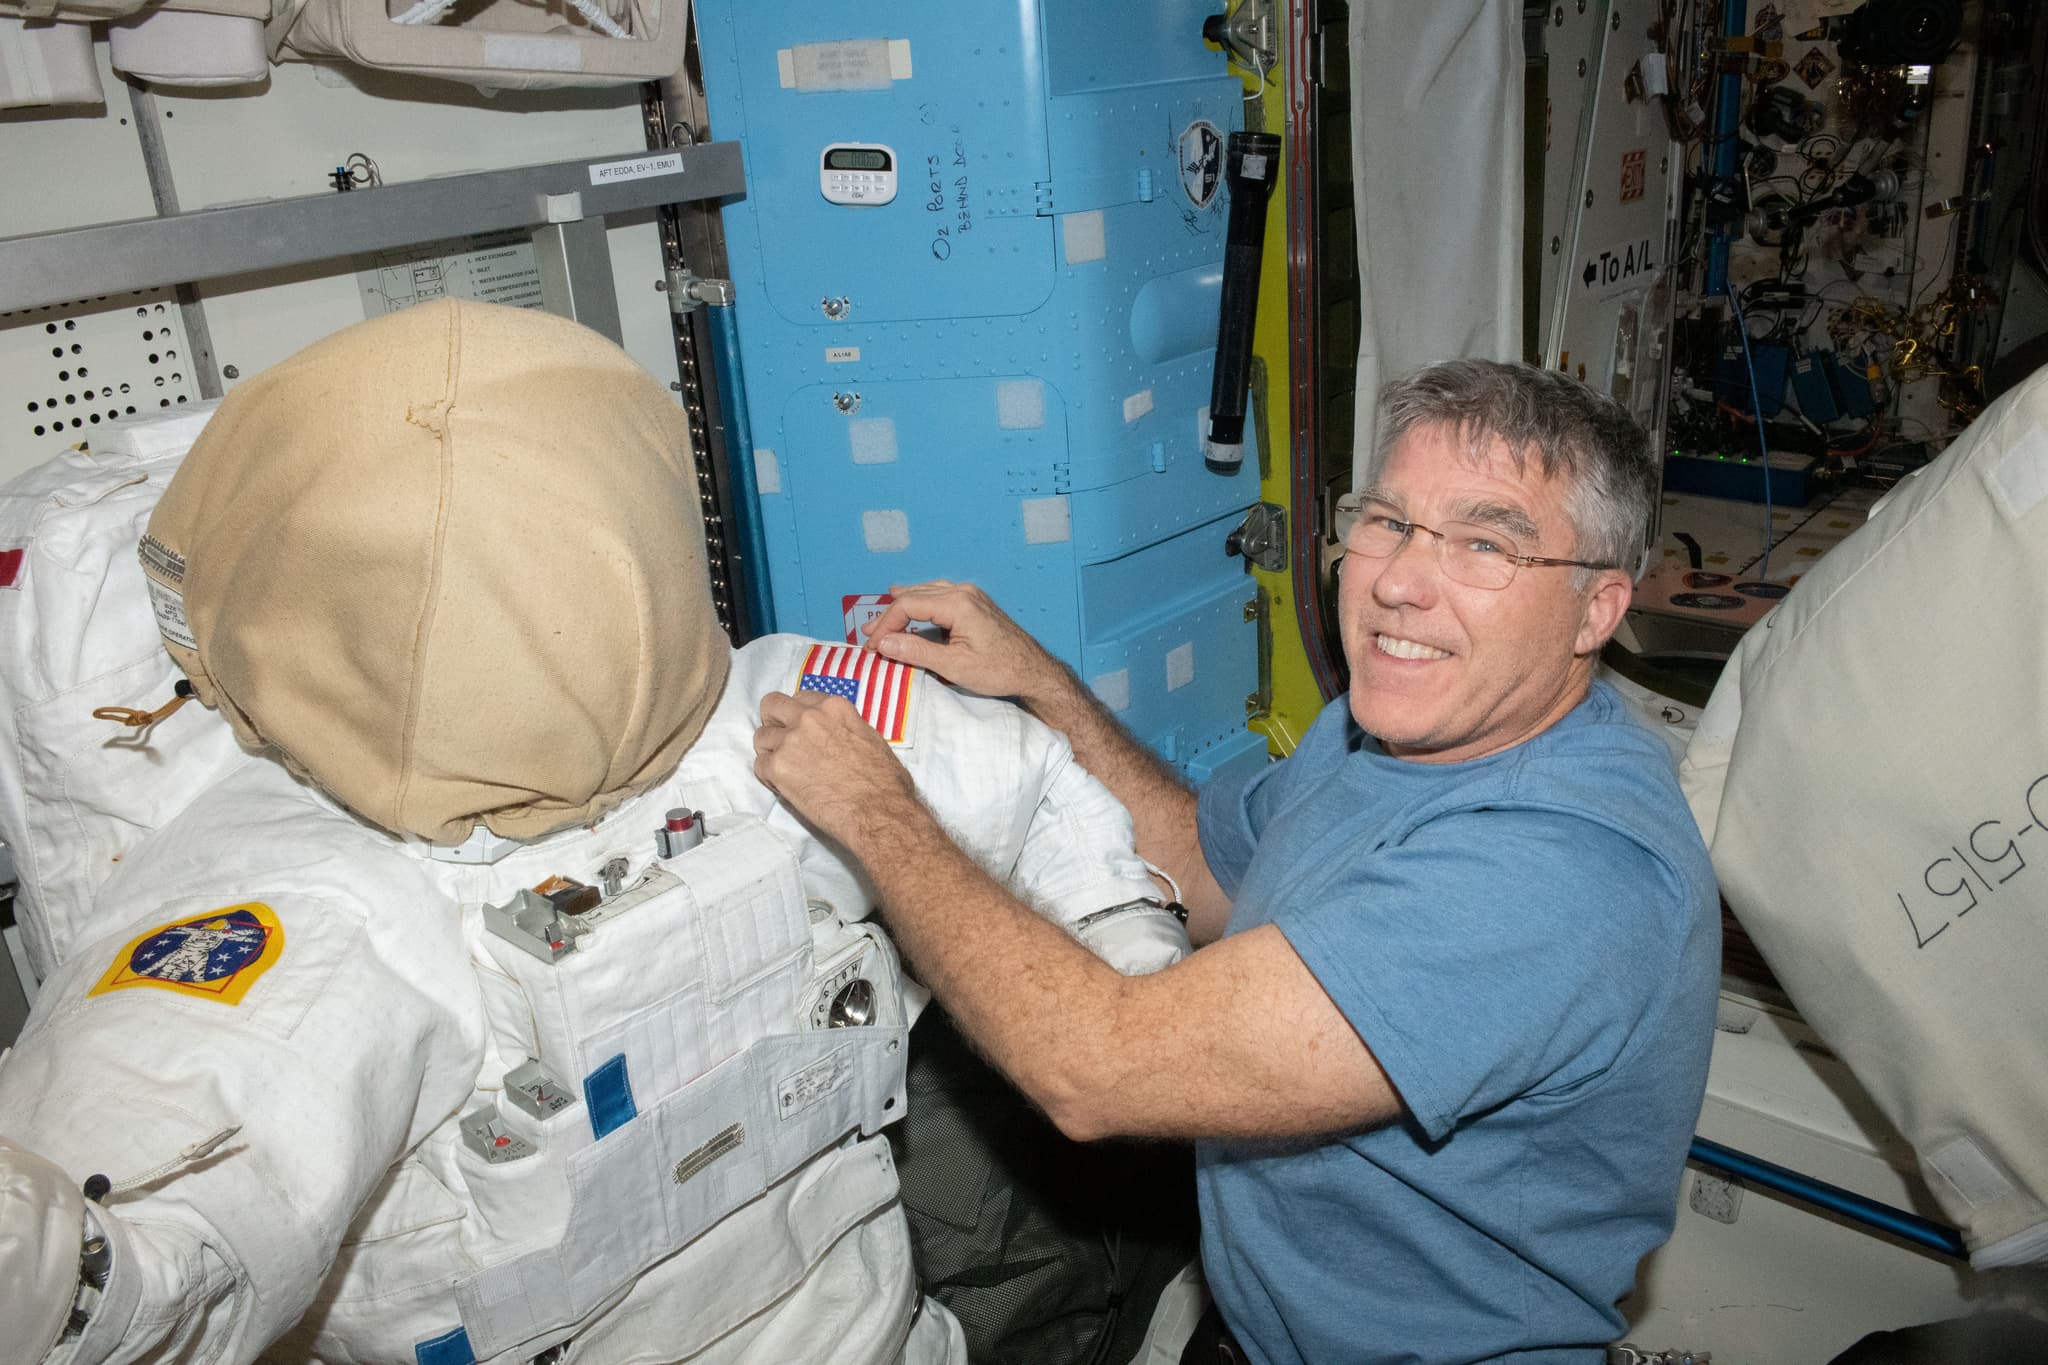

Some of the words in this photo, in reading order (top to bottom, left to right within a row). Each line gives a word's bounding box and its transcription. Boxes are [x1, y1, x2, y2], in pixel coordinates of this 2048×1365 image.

[599, 168, 612, 177] AFT
[657, 159, 675, 170] EMU1
[926, 154, 944, 212] PORTS
[1600, 251, 1619, 286] To
[1623, 239, 1653, 279] A/L
